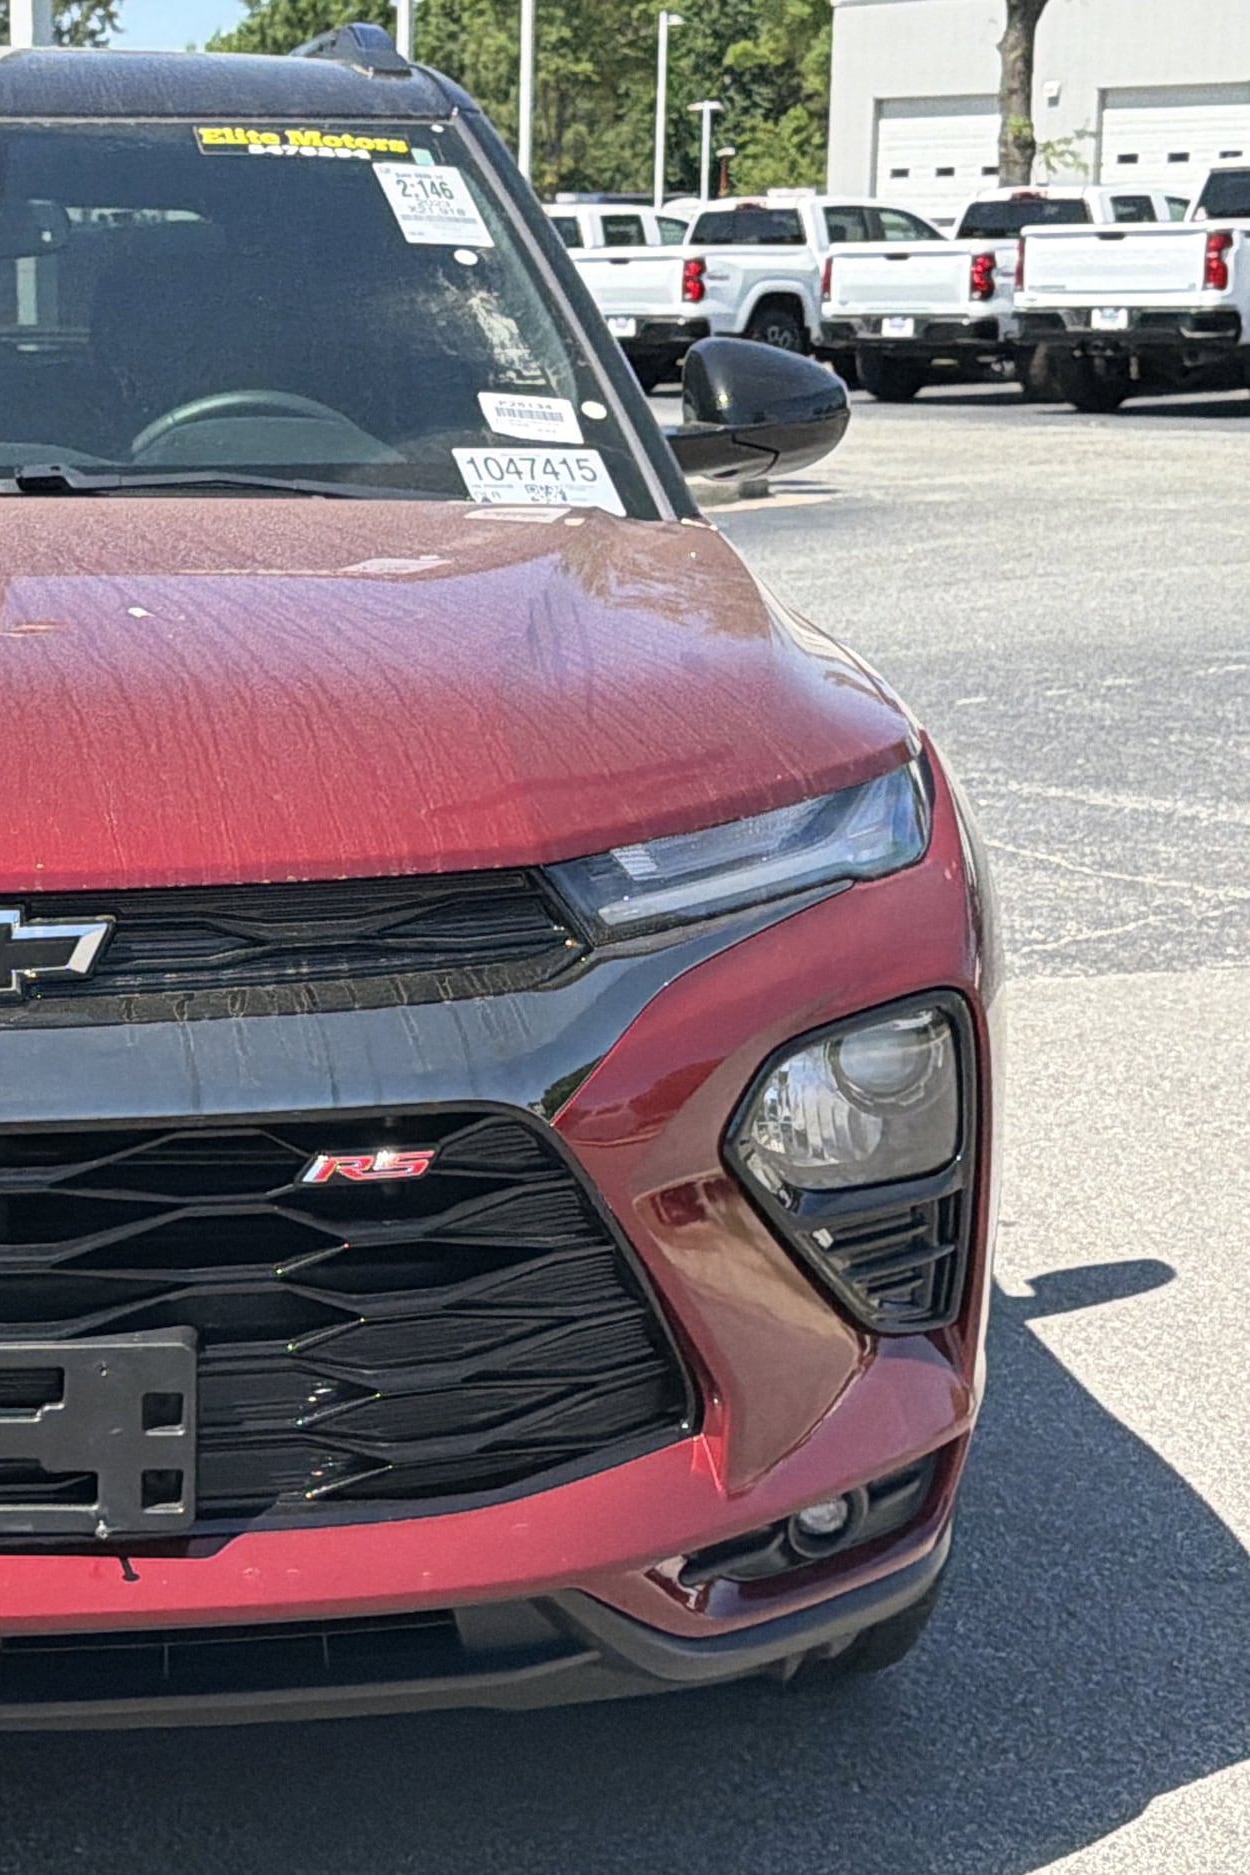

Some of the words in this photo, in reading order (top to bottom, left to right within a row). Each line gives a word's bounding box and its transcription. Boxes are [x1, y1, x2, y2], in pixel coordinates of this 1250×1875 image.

[198, 127, 281, 145] Elite
[285, 129, 409, 154] Motors
[395, 179, 455, 201] 2:146
[466, 456, 598, 482] 1047415
[301, 1150, 436, 1183] RS
